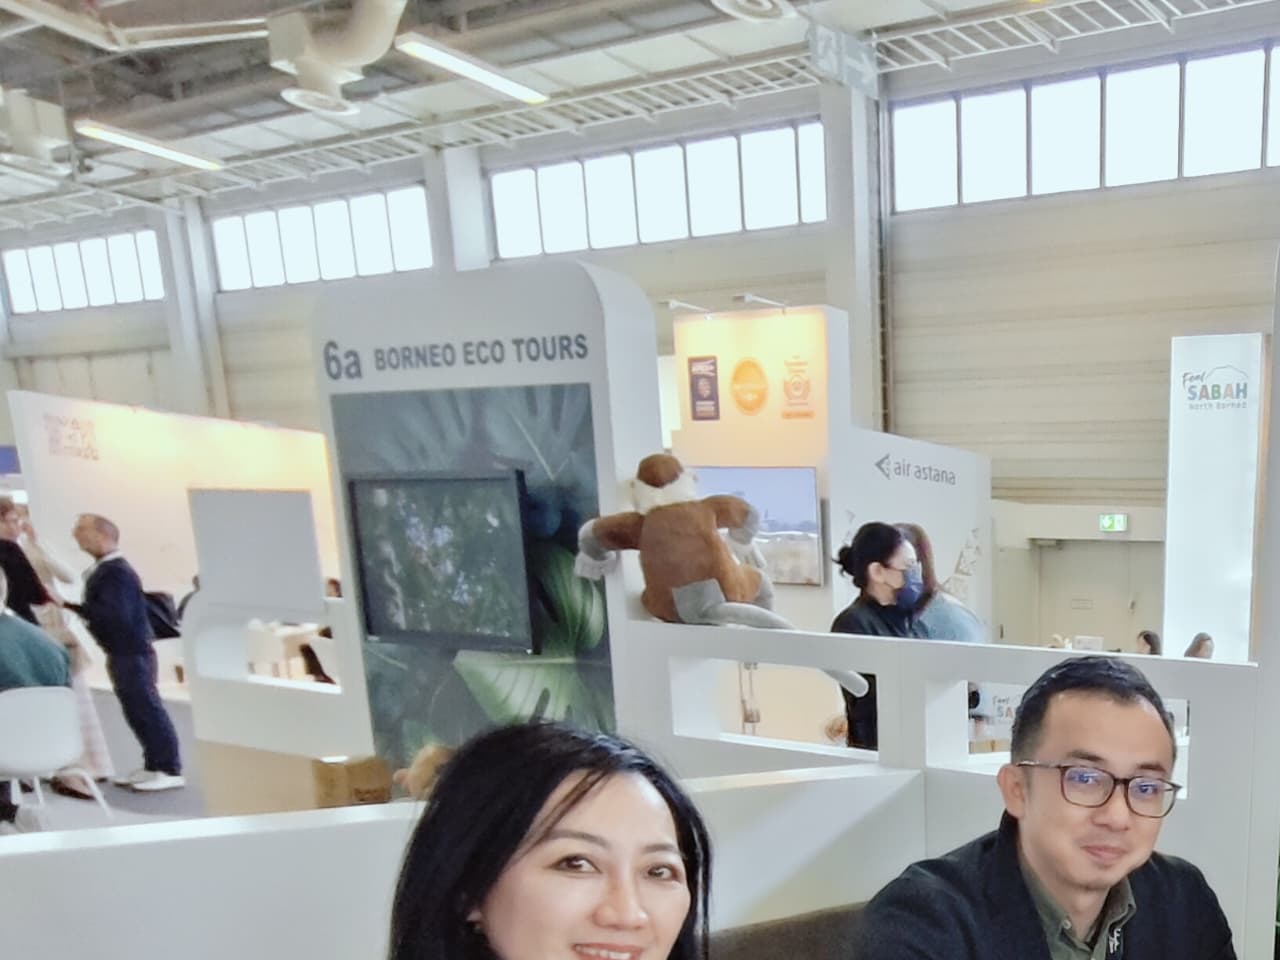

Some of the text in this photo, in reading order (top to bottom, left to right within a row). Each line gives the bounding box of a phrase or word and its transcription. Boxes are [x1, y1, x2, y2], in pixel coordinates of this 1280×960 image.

[323, 340, 363, 381] 6a
[373, 333, 590, 371] BORNEO ECO TOURS
[1187, 382, 1248, 401] SABAH
[893, 459, 957, 486] air astana
